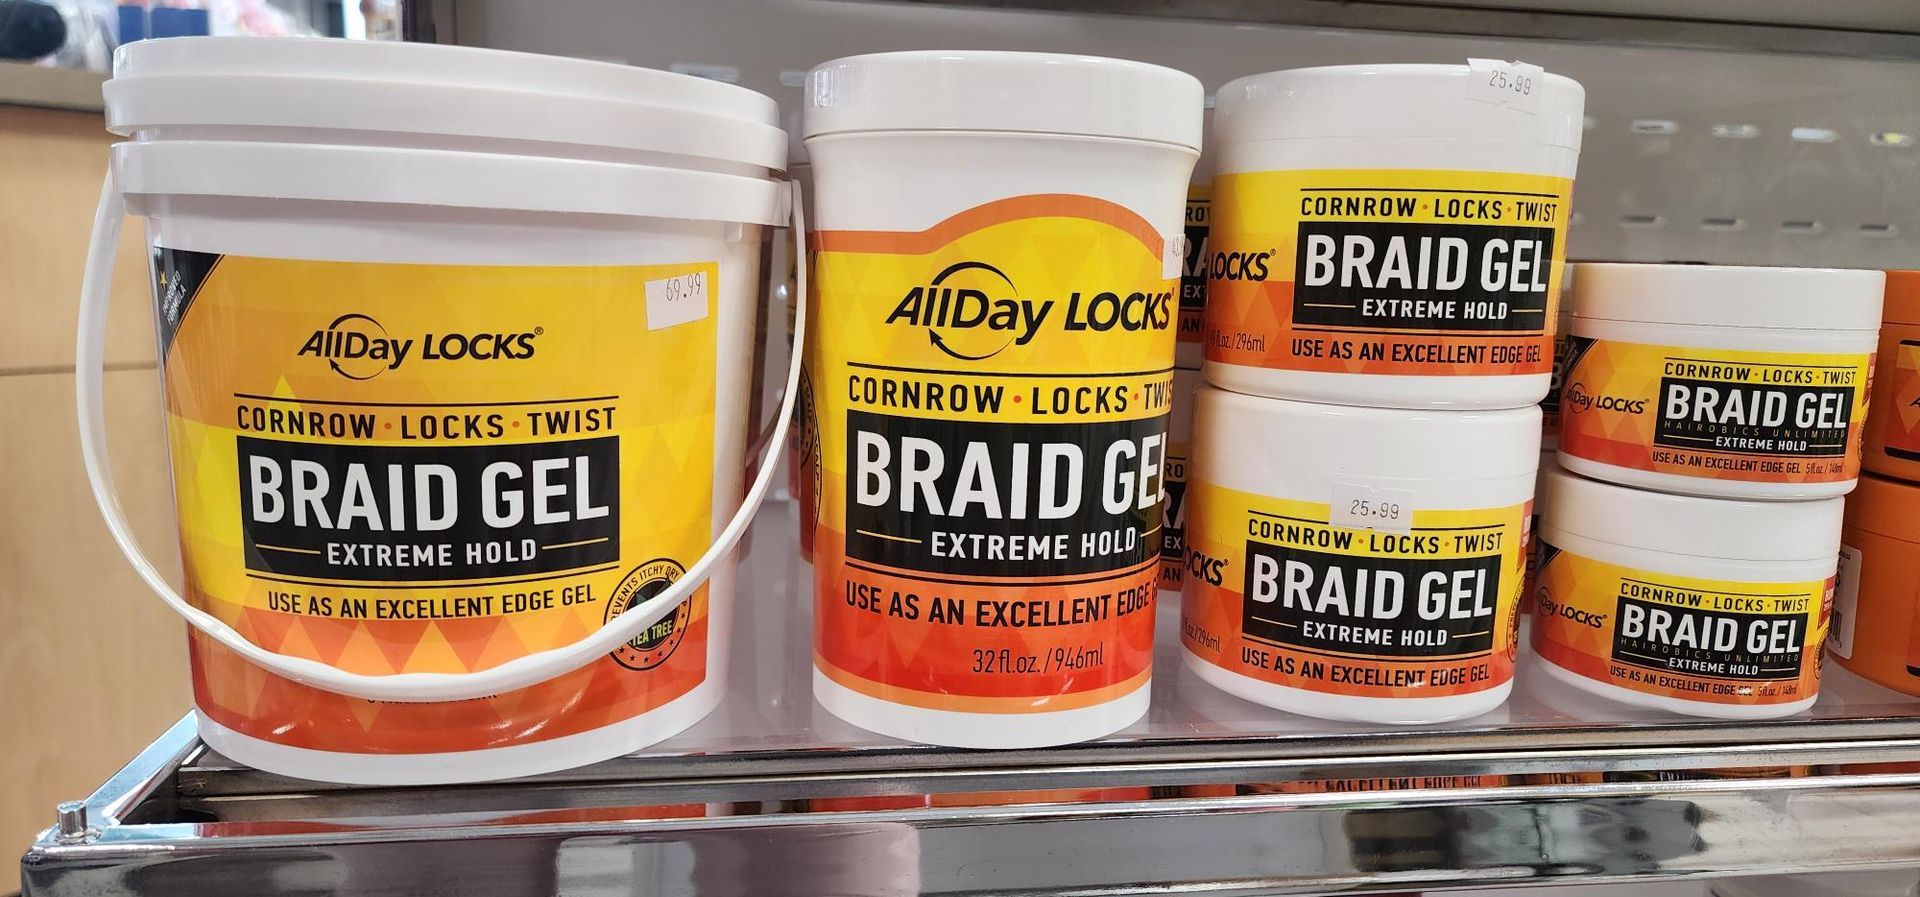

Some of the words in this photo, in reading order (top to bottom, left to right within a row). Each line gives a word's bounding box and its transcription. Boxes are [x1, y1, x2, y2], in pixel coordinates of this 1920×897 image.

[1488, 69, 1532, 97] 25.99
[1301, 196, 1417, 218] CORNROW
[1434, 199, 1502, 220] LOCKS
[1515, 202, 1557, 223] TWIST
[1304, 234, 1473, 293] BRAID
[1480, 237, 1547, 294] GEL
[665, 272, 701, 302] 69.99
[886, 287, 1055, 346] AllDay
[1362, 299, 1456, 319] EXTREME
[1463, 301, 1508, 321] HOLD
[297, 328, 413, 371] AllDay
[1291, 338, 1323, 358] USE
[1329, 341, 1353, 361] AS
[1359, 342, 1385, 362] AN
[1391, 343, 1485, 364] EXCELLENT
[1491, 345, 1522, 364] EDGE
[1526, 345, 1541, 363] GEL
[1664, 362, 1750, 380] CORNROW
[1763, 369, 1814, 384] LOCKS
[1823, 371, 1856, 385] TWIST
[848, 375, 1005, 414] CORNROW
[1032, 385, 1128, 416] LOCKS
[1144, 379, 1173, 410] TWIS
[1666, 384, 1787, 427] BRAID
[1795, 392, 1847, 429] GEL
[237, 405, 377, 439] CORNROW
[401, 413, 504, 440] LOCKS
[527, 407, 616, 436] TWIST
[1665, 420, 1759, 436] HAIROBICS
[1773, 429, 1845, 439] UNLIMITED
[1716, 436, 1773, 450] EXTREME
[1777, 439, 1807, 451] HOLD
[856, 429, 1084, 519] BRAID
[1102, 431, 1167, 516] GEL
[1652, 452, 1670, 464] USE
[1673, 454, 1685, 465] AS
[1688, 455, 1701, 466] AN
[1705, 457, 1758, 472] EXCELLENT
[1761, 461, 1784, 473] EDGE
[1786, 462, 1801, 474] GEL
[249, 454, 458, 532] BRAID
[480, 455, 610, 530] GEL
[1349, 499, 1400, 520] 25.99
[931, 531, 1069, 561] EXTREME
[1081, 526, 1136, 559] HOLD
[1248, 518, 1353, 550] CORNROW
[1369, 535, 1440, 555] LOCKS
[1453, 531, 1503, 553] TWIST
[327, 541, 453, 567] EXTREME
[466, 538, 537, 565] HOLD
[639, 564, 664, 581] ITCHY
[1251, 553, 1406, 621] BRAID
[1418, 567, 1493, 621] GEL
[267, 590, 302, 614] USE
[308, 596, 332, 617] AS
[340, 597, 367, 618] AN
[376, 595, 494, 620] EXCELLENT
[503, 590, 555, 615] EDGE
[562, 584, 596, 606] GEL
[846, 579, 882, 614] USE
[889, 592, 920, 620] AS
[928, 599, 965, 627] AN
[976, 594, 1112, 628] EXCELLENT
[1117, 581, 1151, 617] EDGE
[1620, 582, 1702, 607] CORNROW
[1714, 597, 1764, 613] LOCKS
[1774, 597, 1810, 613] TWIST
[652, 619, 673, 641] TREE
[1303, 620, 1393, 646] EXTREME
[1400, 628, 1448, 646] HOLD
[1621, 603, 1738, 653] BRAID
[1746, 618, 1800, 654] GEL
[1620, 637, 1711, 660] HAIROBICS
[1724, 653, 1798, 663] UNLIMITED
[1241, 646, 1270, 671] USE
[1273, 654, 1296, 676] AS
[1300, 660, 1324, 681] AN
[1331, 665, 1426, 688] EXCELLENT
[1429, 667, 1467, 686] EDGE
[1470, 663, 1490, 682] GEL
[1610, 665, 1626, 679] USE
[1629, 669, 1641, 682] AS
[1643, 674, 1656, 685] AN
[1659, 676, 1711, 693] EXCELLENT
[1712, 684, 1736, 695] EDGE
[1669, 657, 1725, 674] EXTREME
[1729, 663, 1758, 676] HOLD
